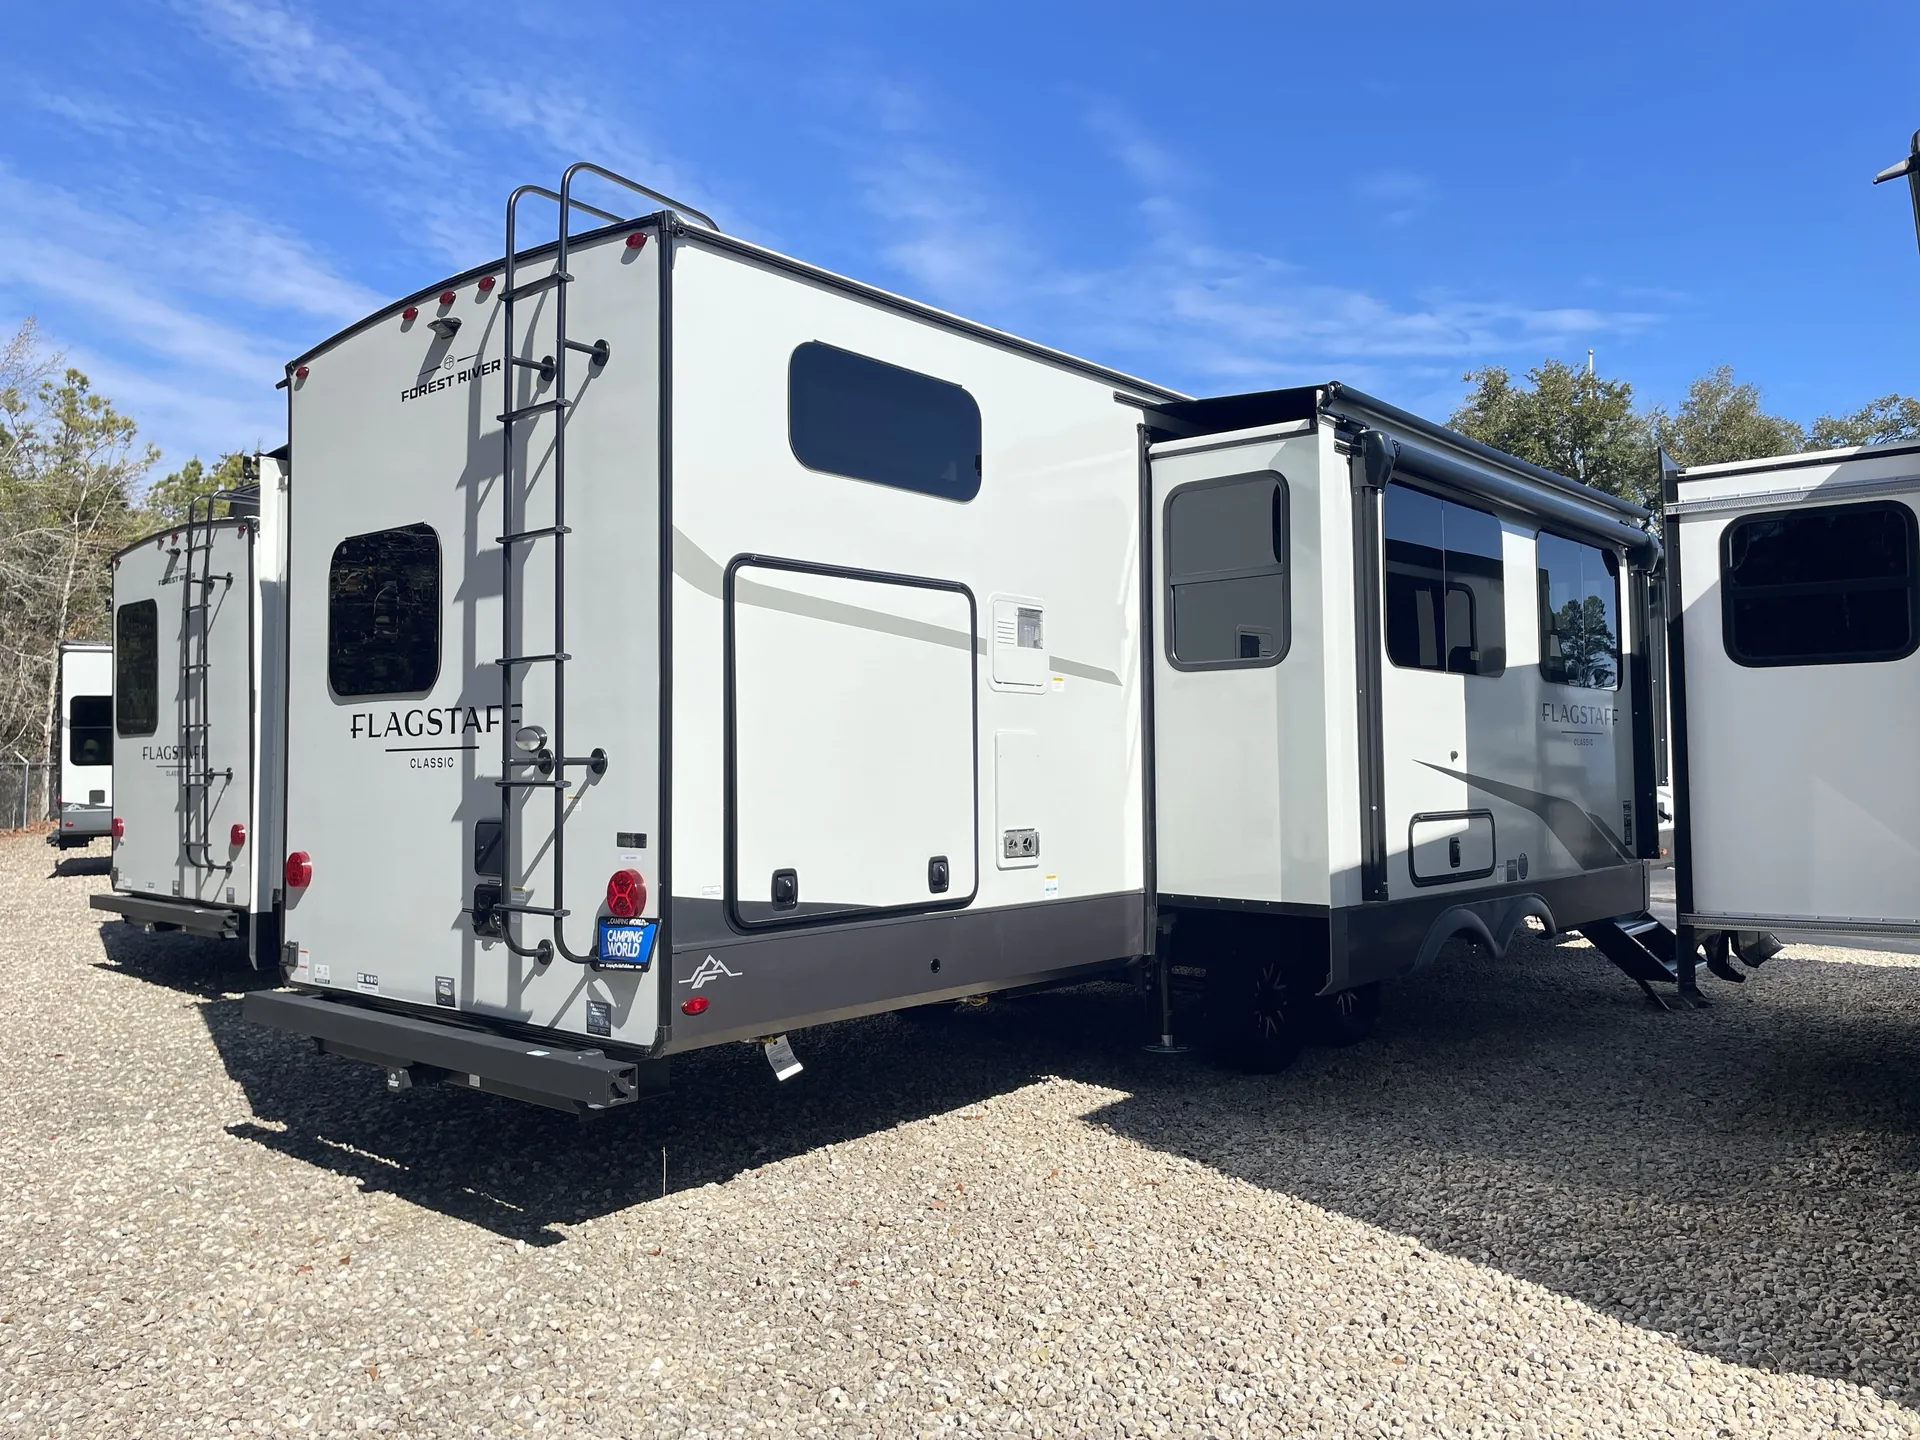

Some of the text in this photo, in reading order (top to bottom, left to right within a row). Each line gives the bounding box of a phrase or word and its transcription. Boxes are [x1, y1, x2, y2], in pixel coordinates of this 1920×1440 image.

[401, 359, 501, 402] FOREST RIVER
[1541, 702, 1619, 726] FLAGSTAFF
[1573, 738, 1594, 747] CLASSIC
[410, 757, 454, 769] CLASSIC
[607, 929, 644, 944] CAMPING
[607, 941, 641, 958] WORLD
